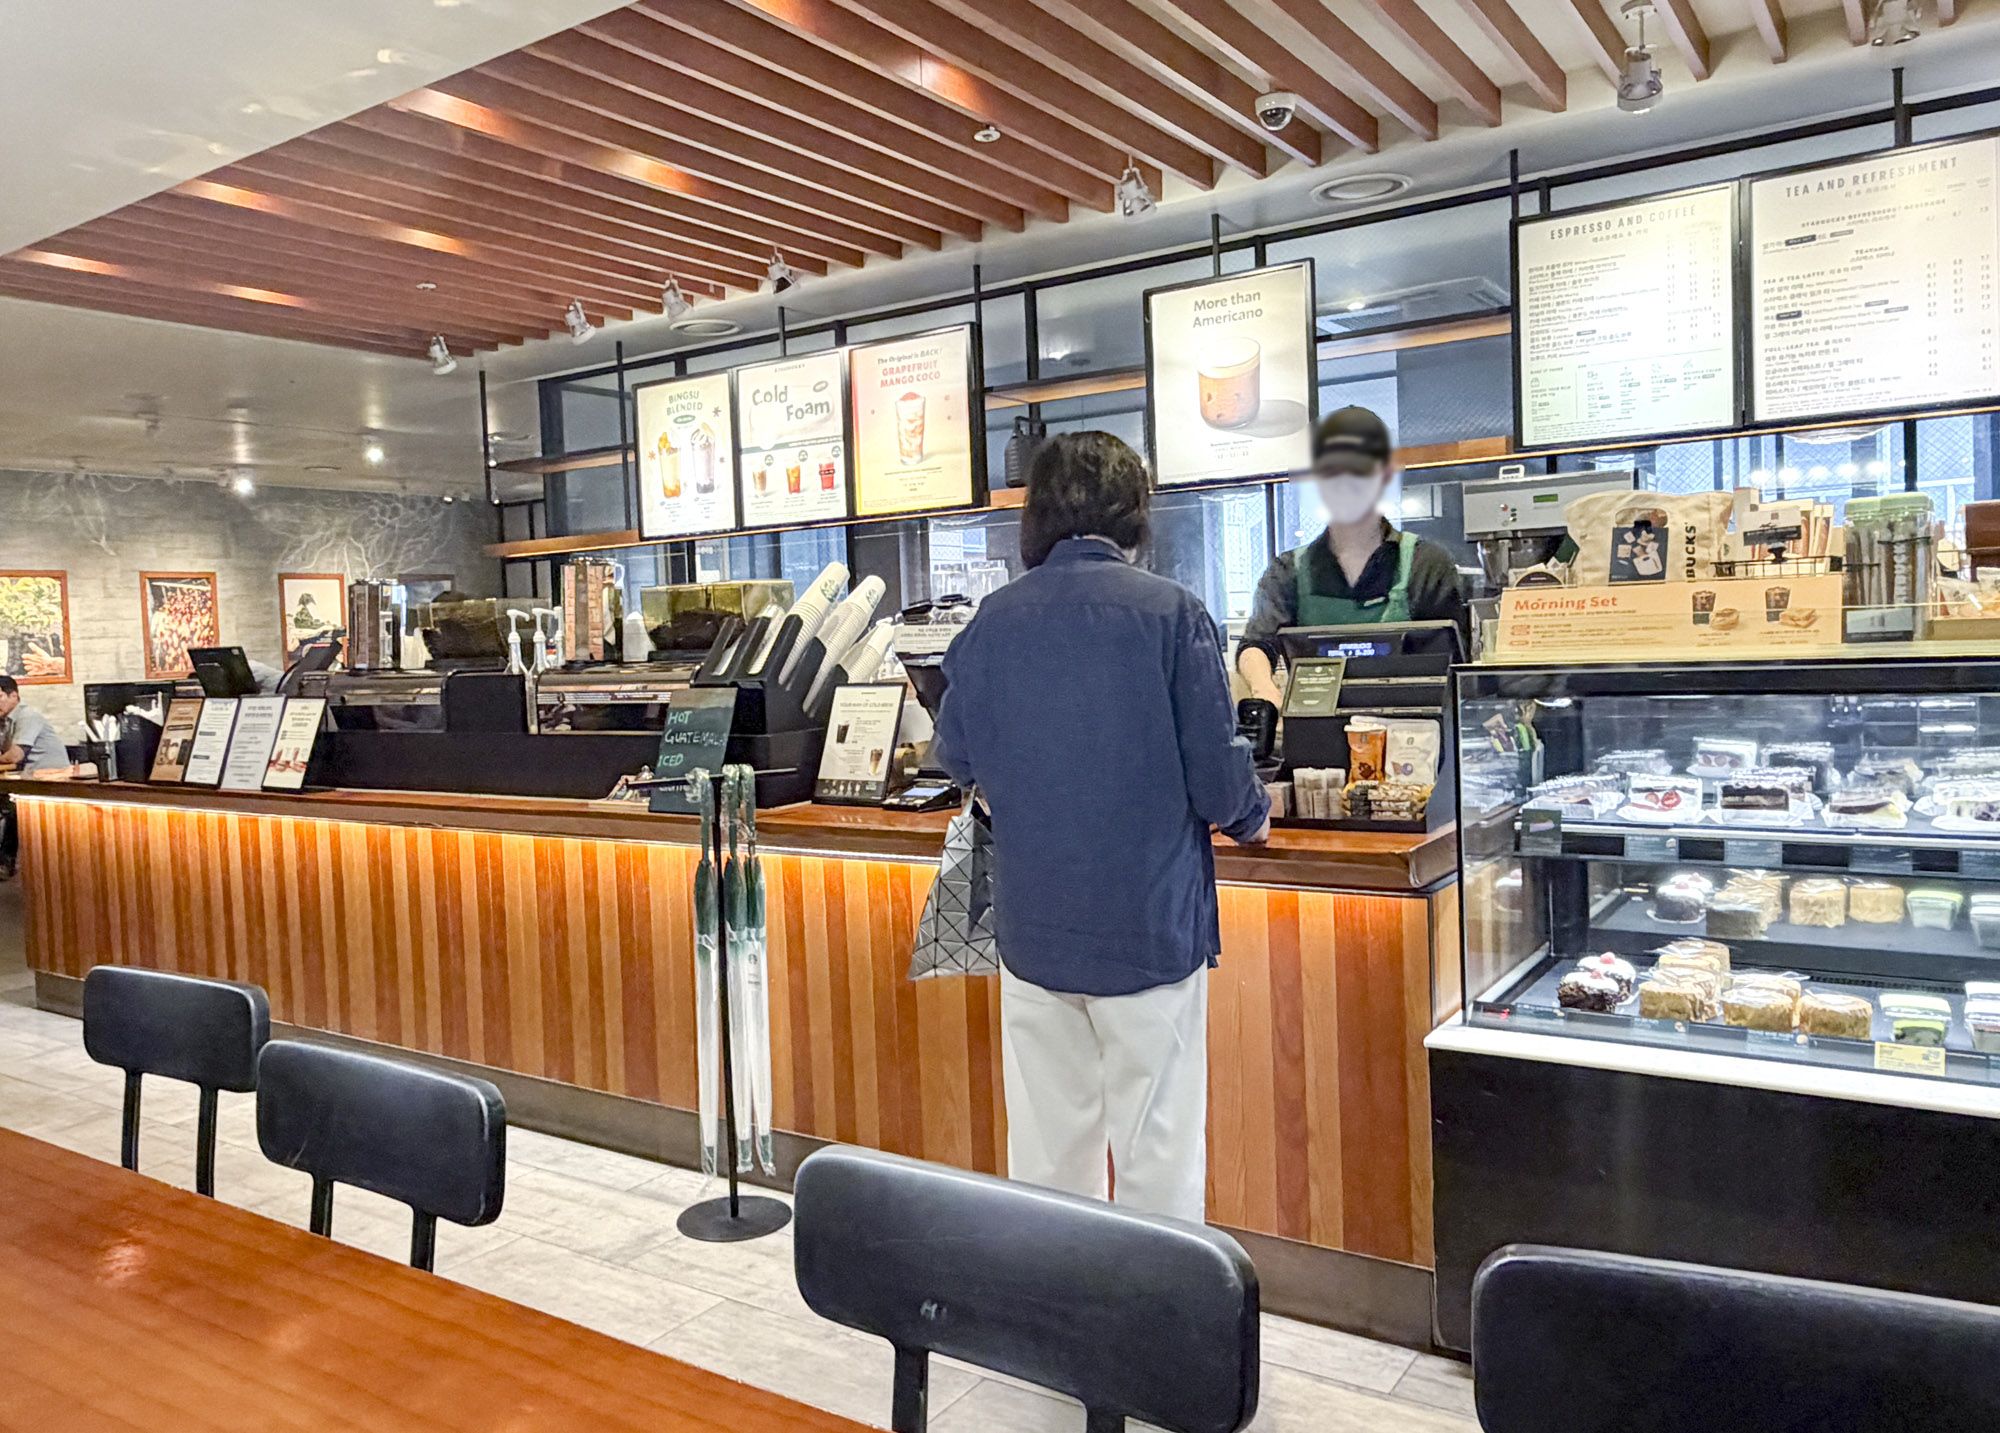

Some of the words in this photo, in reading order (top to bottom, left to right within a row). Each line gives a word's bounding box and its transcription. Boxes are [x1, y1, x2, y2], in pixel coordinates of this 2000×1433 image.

[1786, 183, 1809, 197] TEA
[1817, 177, 1844, 192] AND
[1852, 156, 1957, 185] REFRESHMENT
[1550, 220, 1612, 240] ESPRESSO
[1618, 214, 1643, 228] AND
[1650, 204, 1696, 222] COFFEE
[1194, 298, 1228, 312] More
[1230, 291, 1261, 305] than
[1192, 307, 1264, 329] Americano
[882, 360, 938, 376] GRAPEFRUIT
[880, 375, 914, 388] MANGO
[916, 371, 941, 382] COCO
[668, 390, 700, 404] BINGSU
[752, 384, 788, 406] Cold
[666, 402, 703, 416] BLENDED
[786, 400, 830, 421] Foam
[1514, 597, 1586, 611] Morning
[1590, 596, 1617, 607] Set
[667, 710, 692, 725] HOT
[657, 753, 684, 767] ICED
